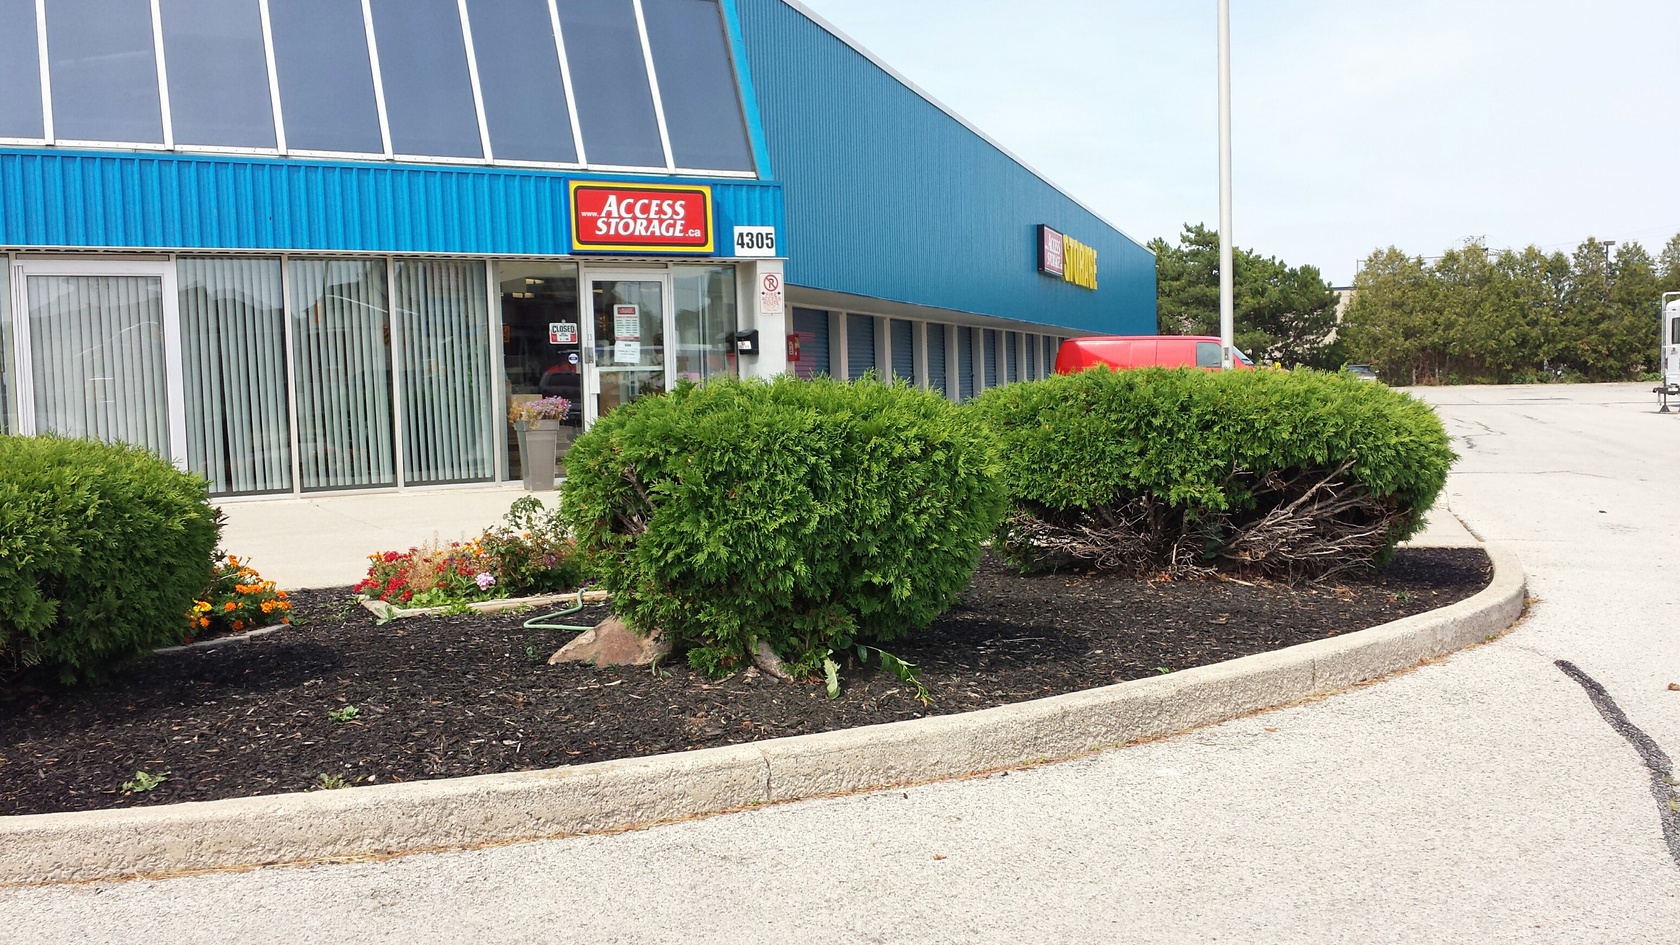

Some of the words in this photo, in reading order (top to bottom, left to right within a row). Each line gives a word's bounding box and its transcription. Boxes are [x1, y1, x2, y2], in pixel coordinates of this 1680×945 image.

[595, 218, 686, 237] STORAGE
[736, 231, 774, 249] 4305
[1063, 234, 1098, 290] STORAGE
[552, 325, 575, 333] CLOSED
